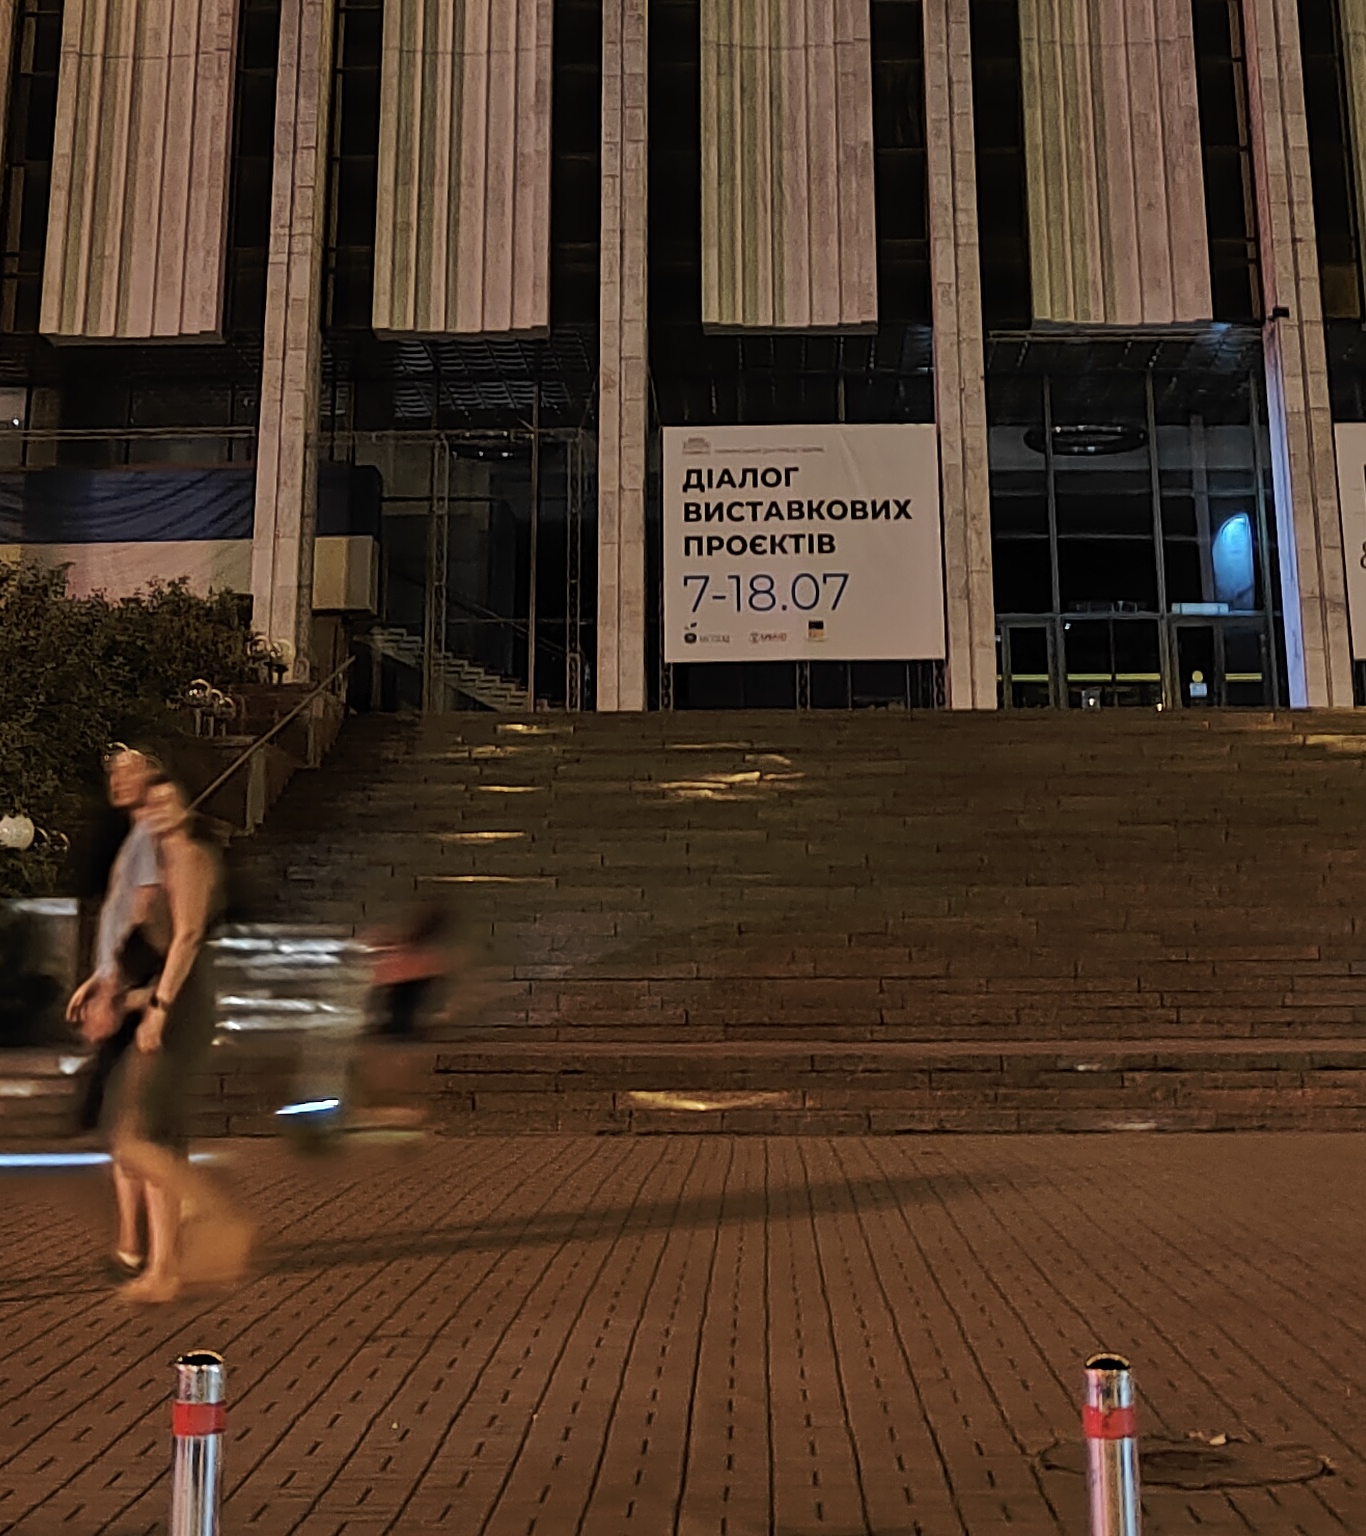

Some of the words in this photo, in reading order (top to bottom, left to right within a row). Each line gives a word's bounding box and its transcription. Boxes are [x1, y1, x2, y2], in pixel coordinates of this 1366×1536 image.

[682, 467, 800, 493] ДІАЛОГ
[683, 498, 913, 523] ВИСТАВКОВИХ
[684, 533, 837, 557] ПРОЄКТІВ
[683, 572, 850, 613] 7-18.07
